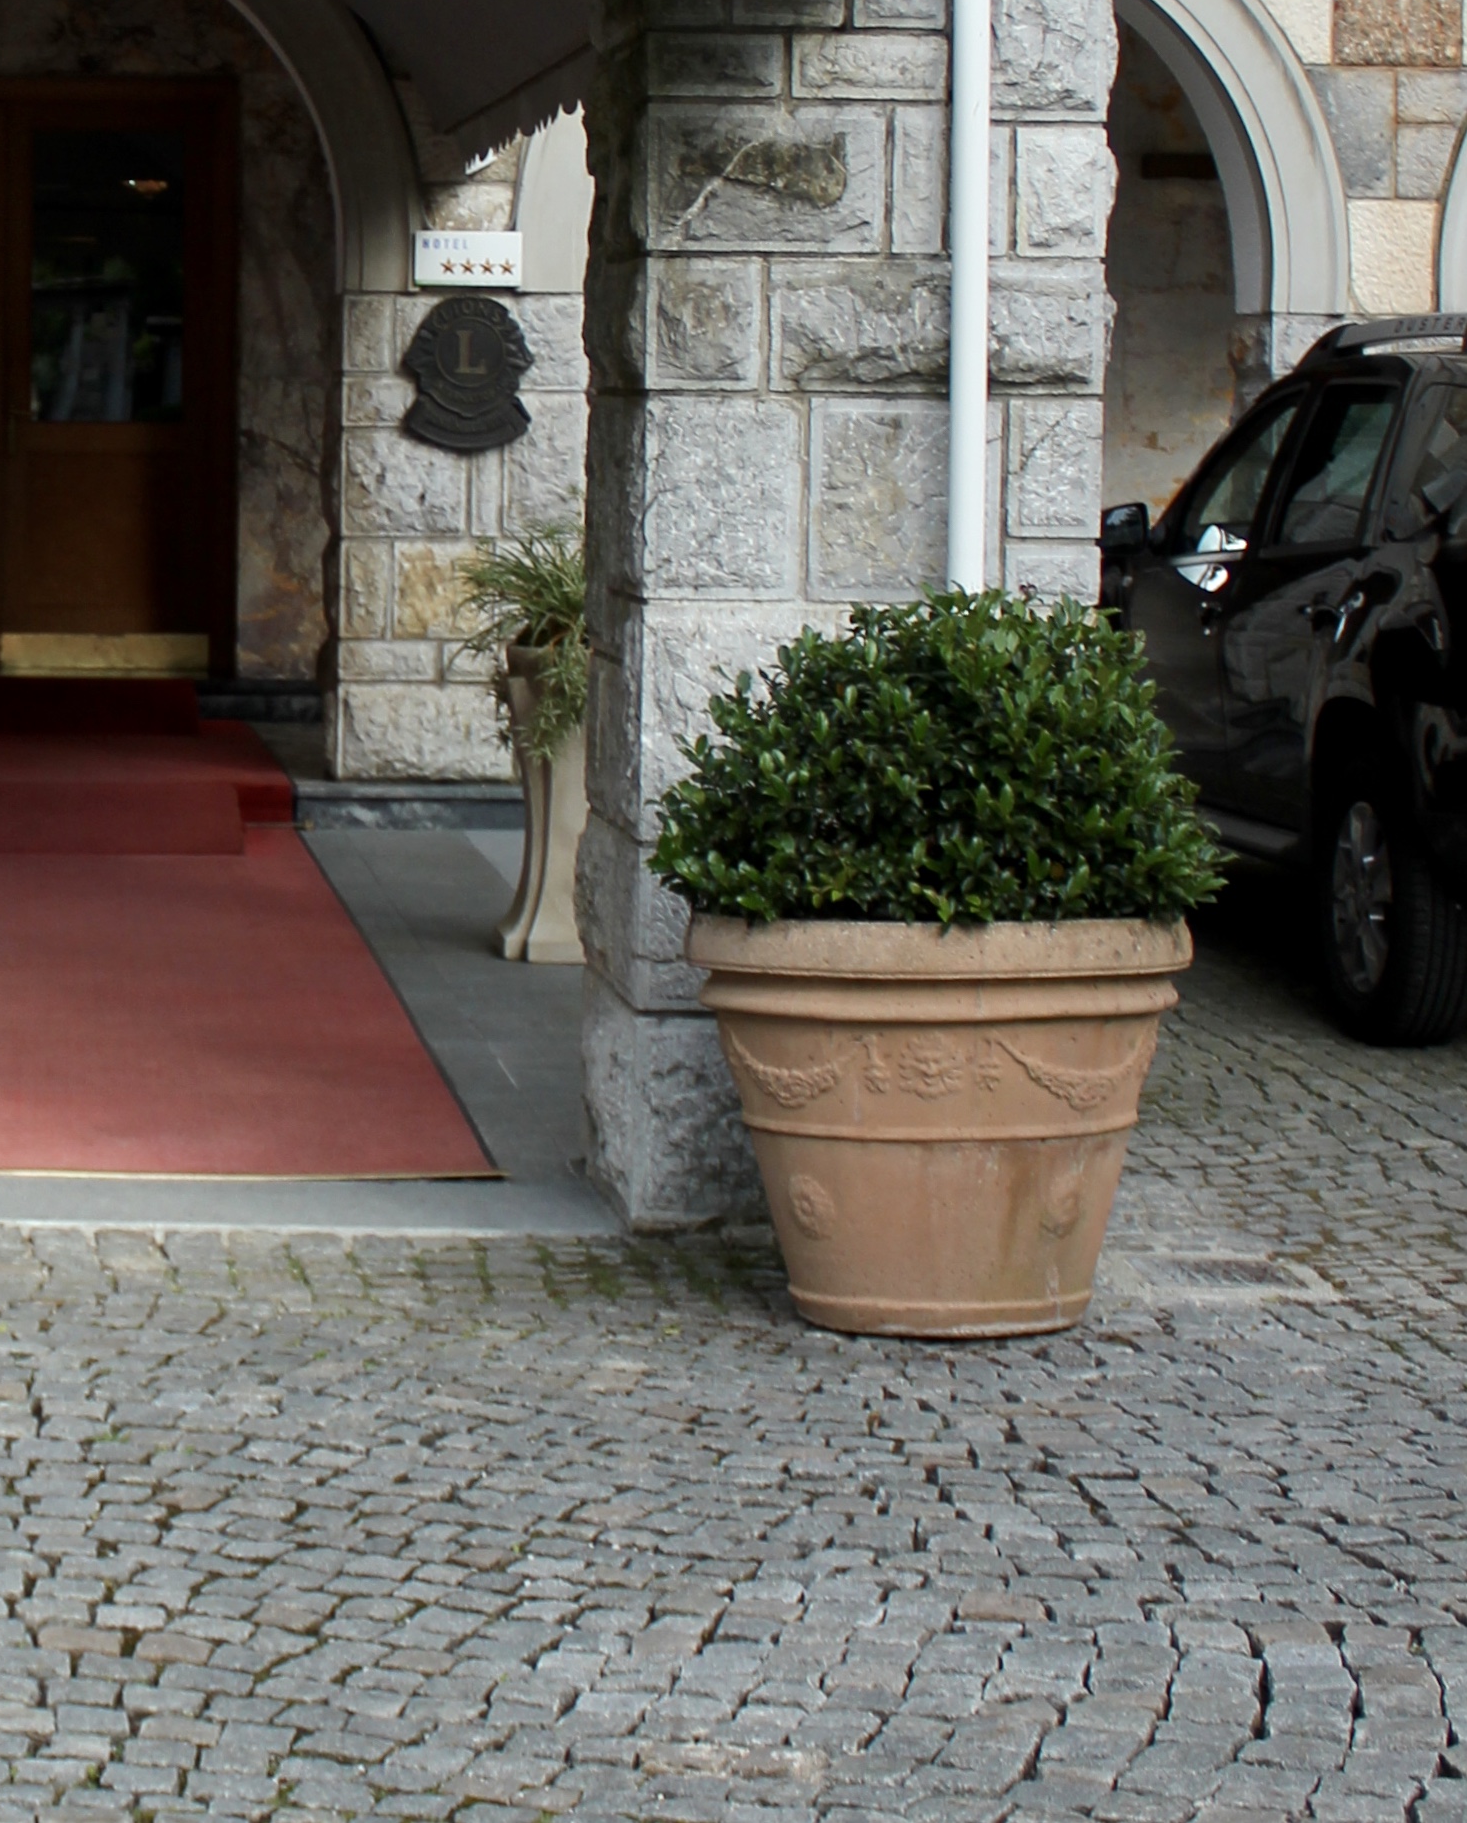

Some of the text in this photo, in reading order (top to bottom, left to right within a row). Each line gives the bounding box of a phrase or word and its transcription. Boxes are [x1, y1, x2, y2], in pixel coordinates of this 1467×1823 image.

[421, 238, 469, 250] HOTEL
[437, 300, 503, 326] LIONS
[1394, 316, 1467, 334] DUSTER
[453, 329, 488, 375] L
